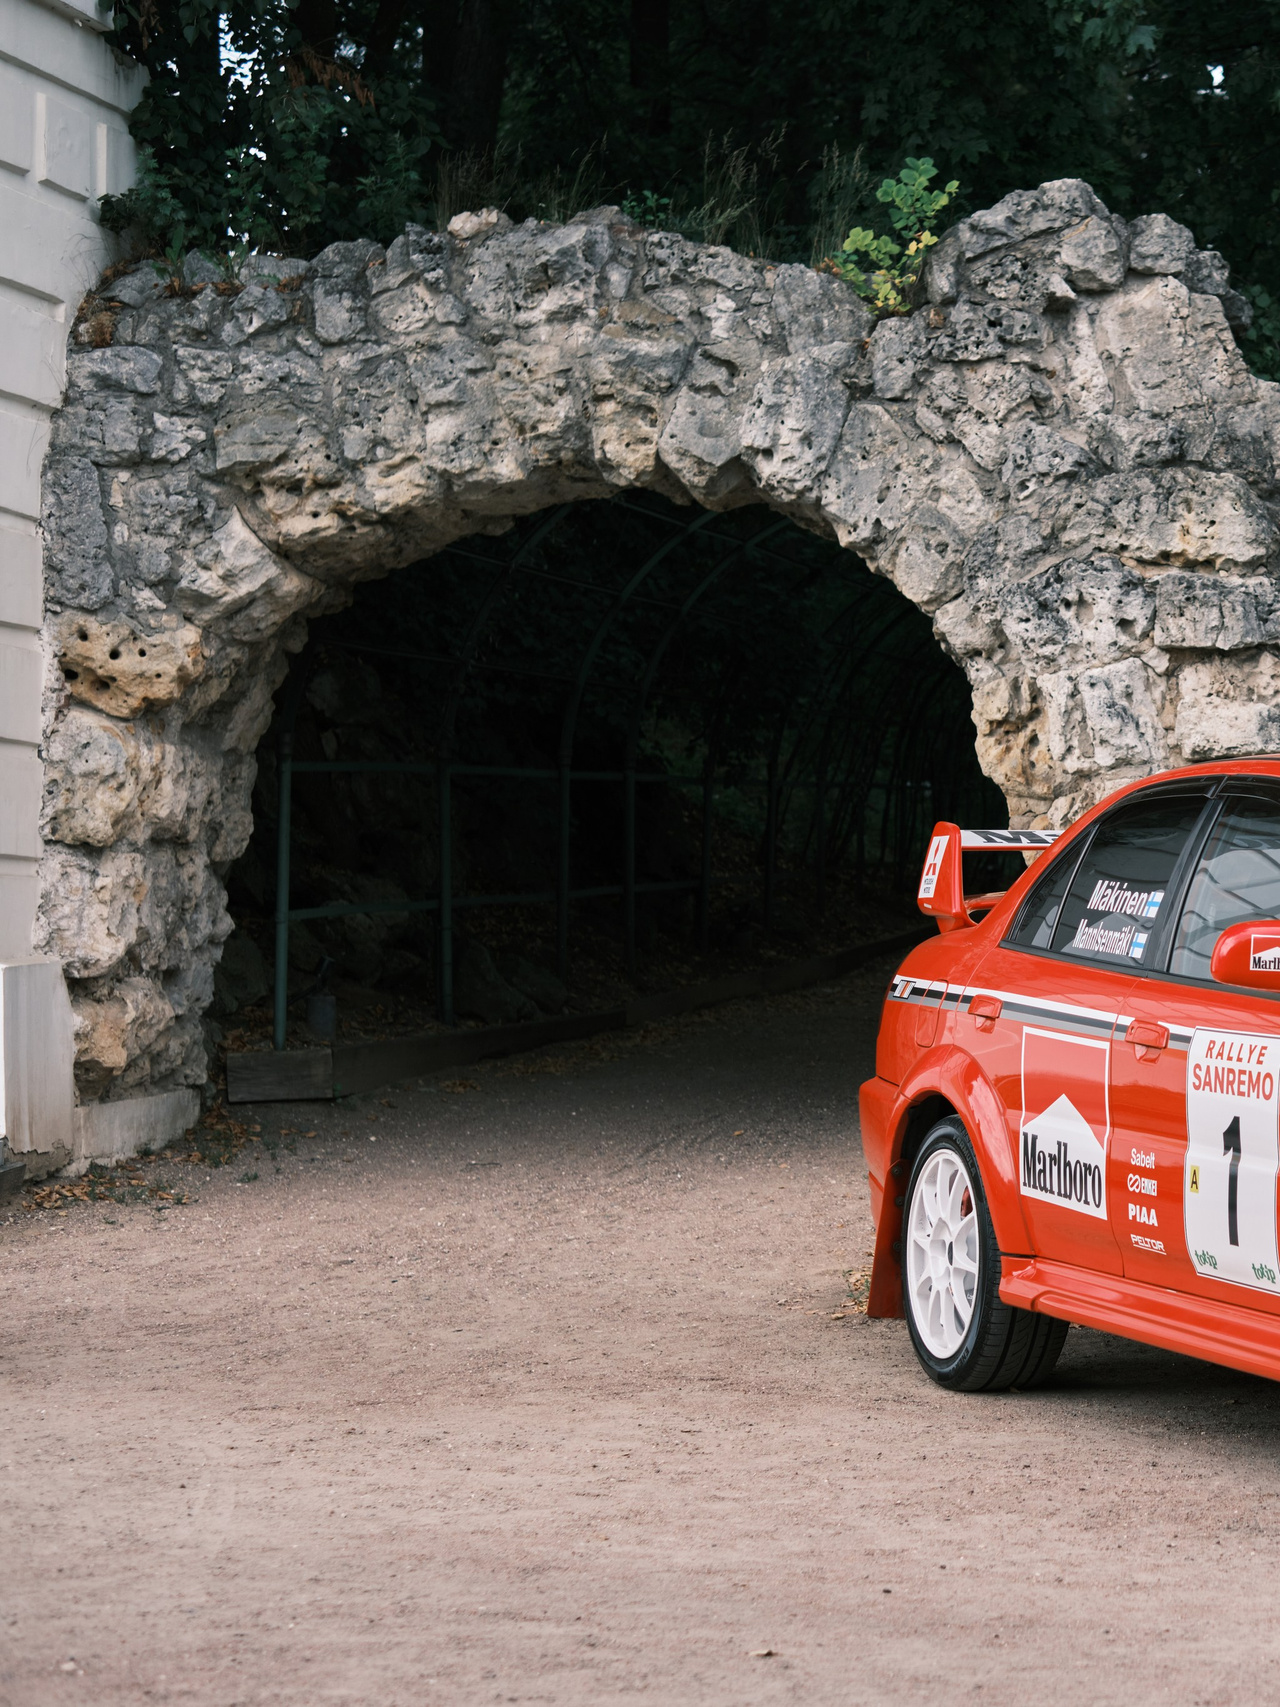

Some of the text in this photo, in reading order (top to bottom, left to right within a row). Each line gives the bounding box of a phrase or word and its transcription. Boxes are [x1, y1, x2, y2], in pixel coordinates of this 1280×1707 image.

[1087, 880, 1148, 917] Mäkinen
[1205, 1040, 1268, 1065] RALLYE
[1192, 1063, 1274, 1101] SANREMO
[1022, 1131, 1102, 1209] Marlboro
[1130, 1148, 1155, 1170] Sabelt
[1141, 1178, 1157, 1197] ENKEI
[1190, 1169, 1199, 1190] A
[1222, 1116, 1241, 1247] 1
[1128, 1203, 1159, 1227] PIAA
[1130, 1234, 1165, 1252] PELTOR
[1194, 1249, 1276, 1284] totip totip
